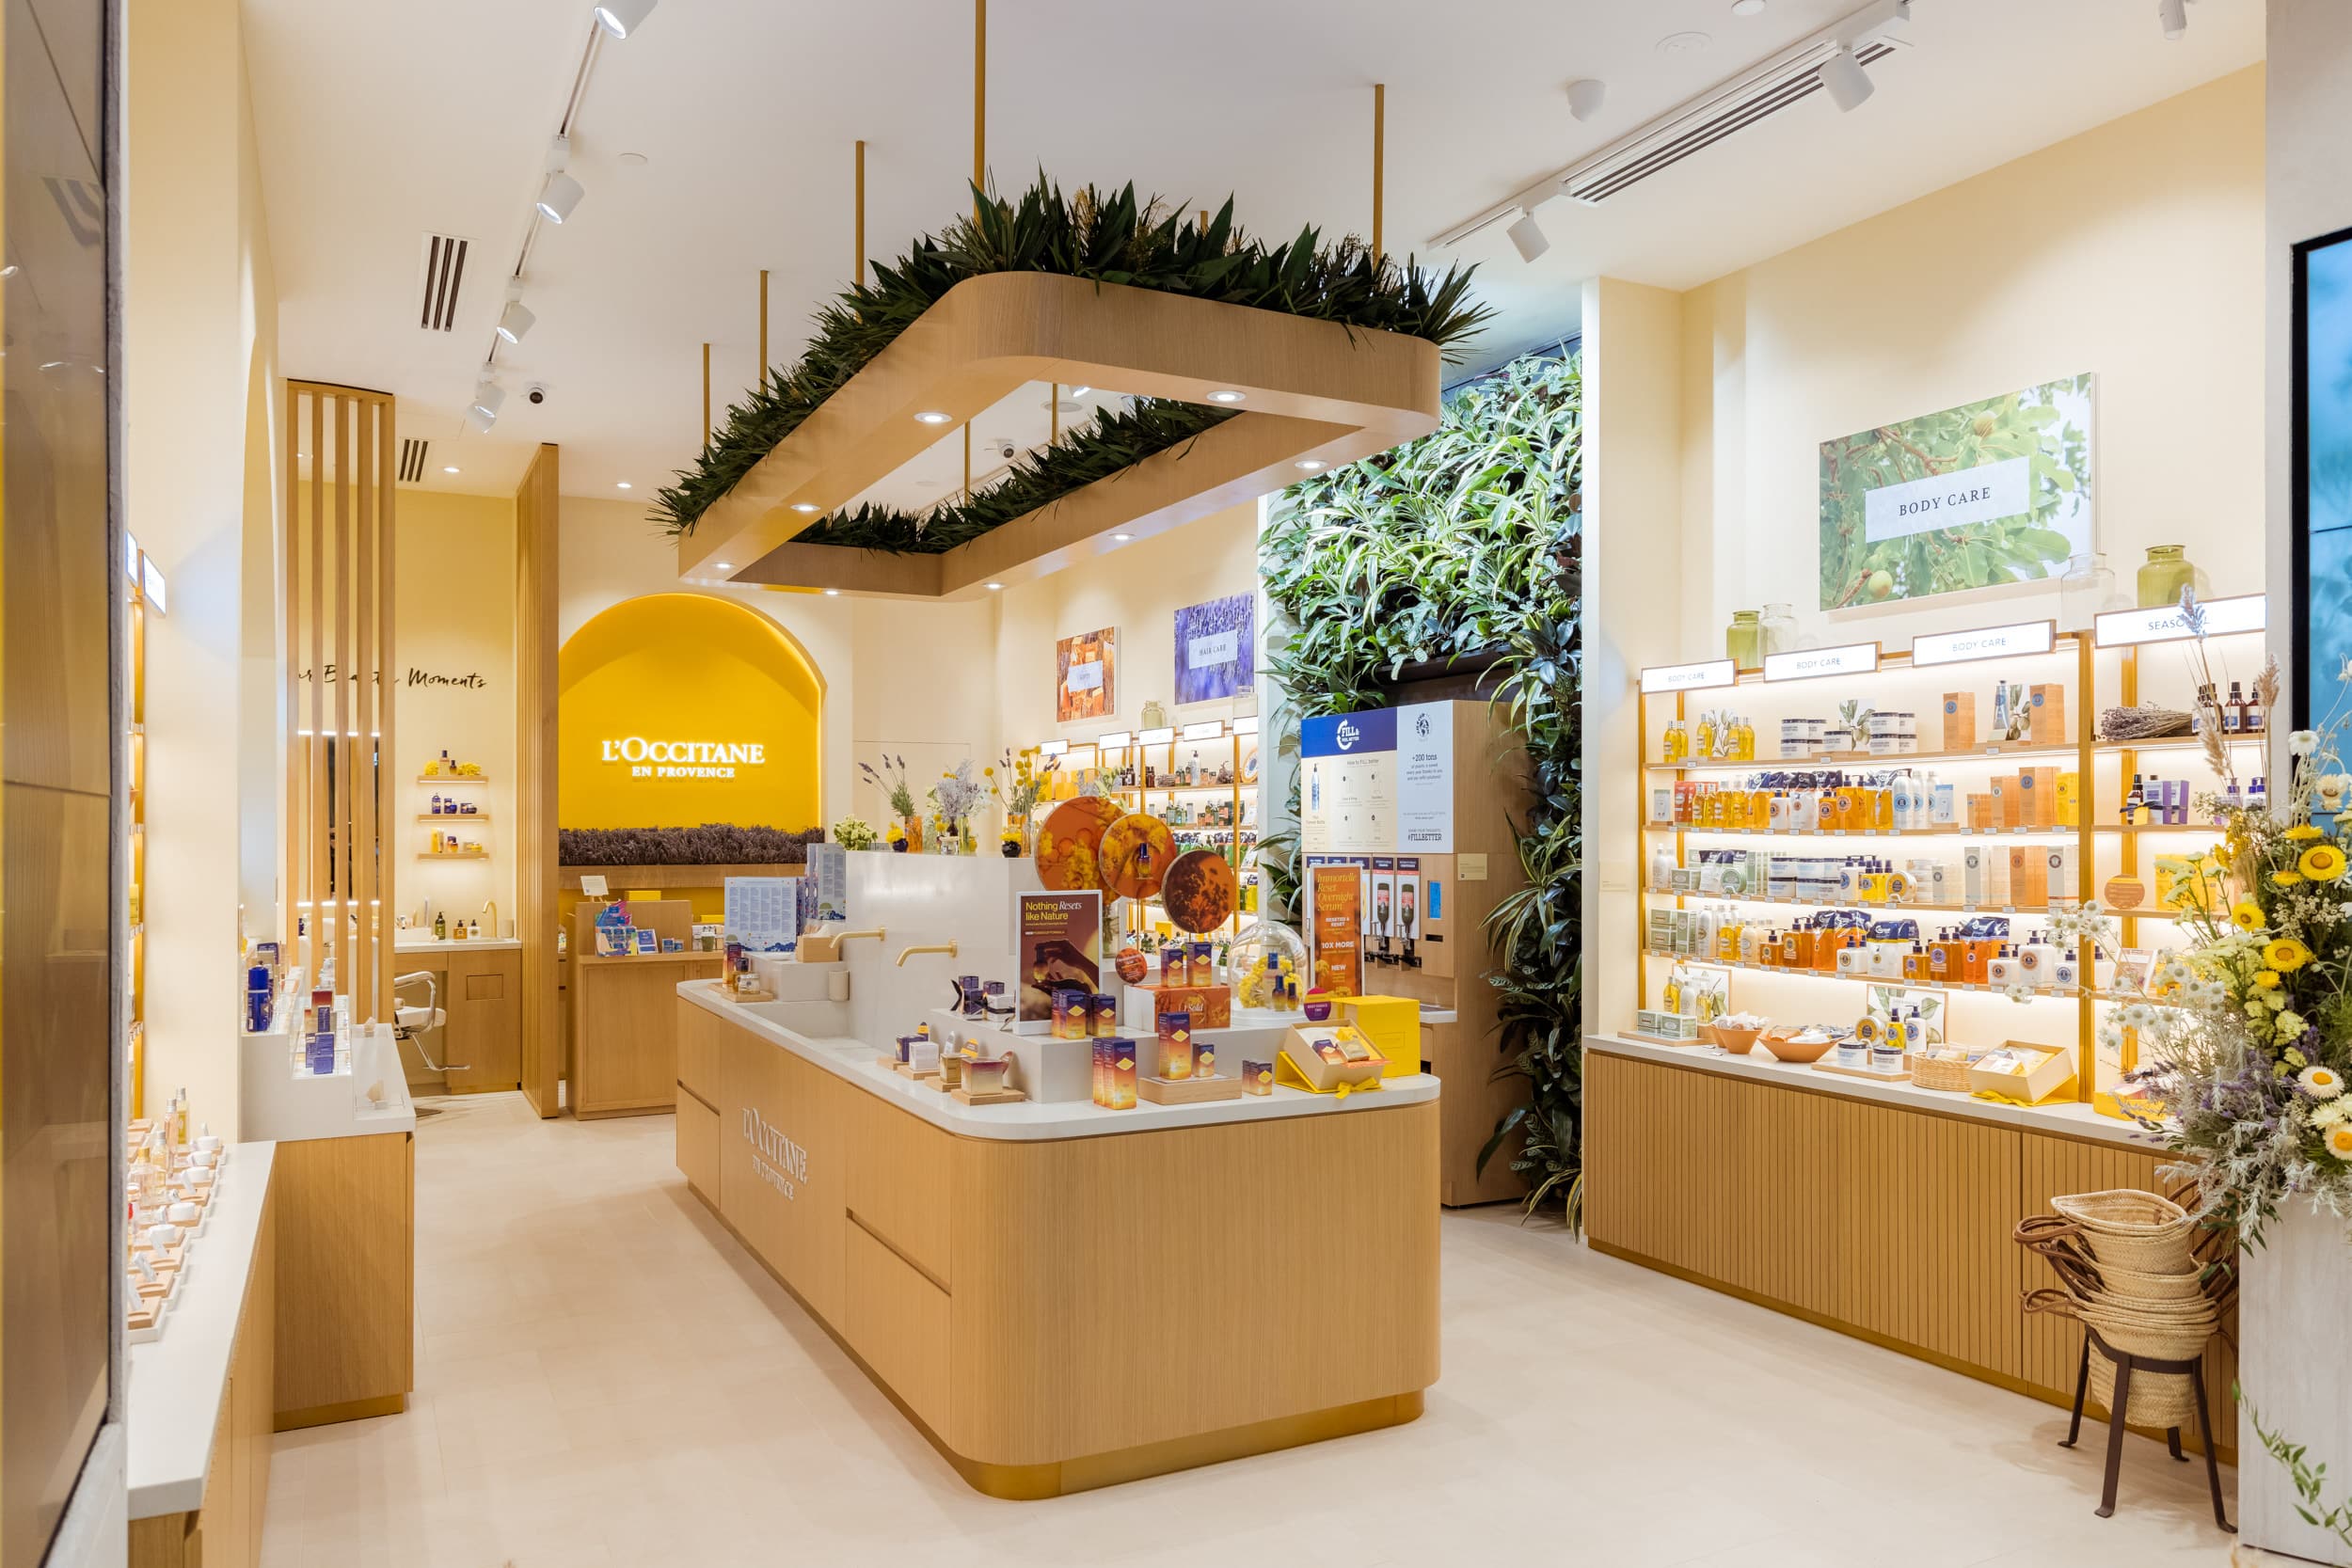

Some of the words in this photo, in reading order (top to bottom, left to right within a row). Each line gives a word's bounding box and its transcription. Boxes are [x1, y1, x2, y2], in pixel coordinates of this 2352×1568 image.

[1899, 497, 1941, 516] BODY
[1947, 486, 1991, 506] CARE
[2148, 616, 2210, 631] SEASOL
[1200, 646, 1213, 657] HAIR
[1952, 641, 1979, 652] BODY
[1981, 638, 2007, 648] CARE
[1796, 660, 1818, 670] BODY
[1820, 657, 1841, 667] CARE
[408, 667, 487, 689] Moments
[601, 736, 766, 764] L'OCCITANE
[631, 766, 652, 778] EN
[658, 767, 736, 779] PROVENCE
[1318, 883, 1337, 893] Reset
[1317, 892, 1354, 903] Overnight
[1025, 902, 1058, 912] Nothing
[1059, 901, 1083, 911] Resets
[1317, 903, 1343, 911] Serum
[1025, 912, 1040, 921] like
[1041, 912, 1069, 921] Nature
